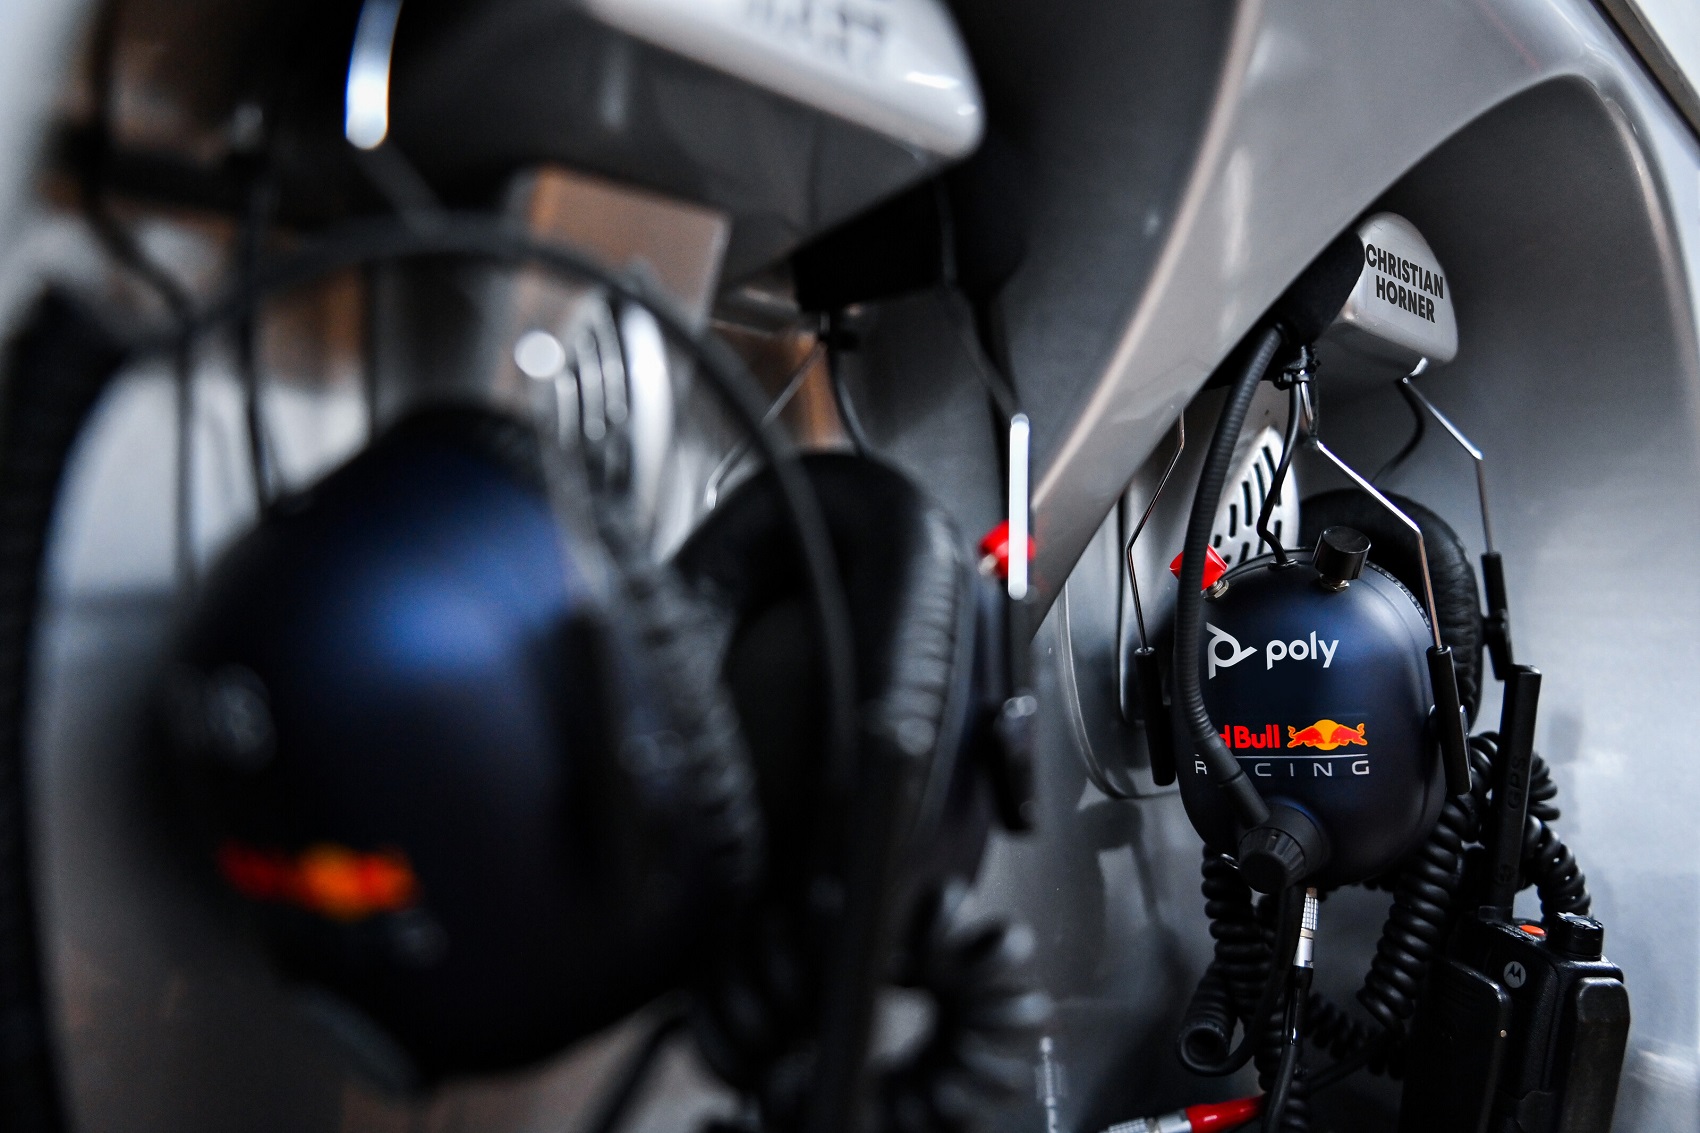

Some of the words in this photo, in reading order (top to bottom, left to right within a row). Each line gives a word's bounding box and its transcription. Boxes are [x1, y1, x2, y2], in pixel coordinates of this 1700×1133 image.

[1366, 243, 1444, 299] CHRISTIAN
[1375, 275, 1436, 323] HORNER
[1266, 630, 1340, 671] poly
[1233, 723, 1281, 749] Bull
[1194, 760, 1370, 777] RCING
